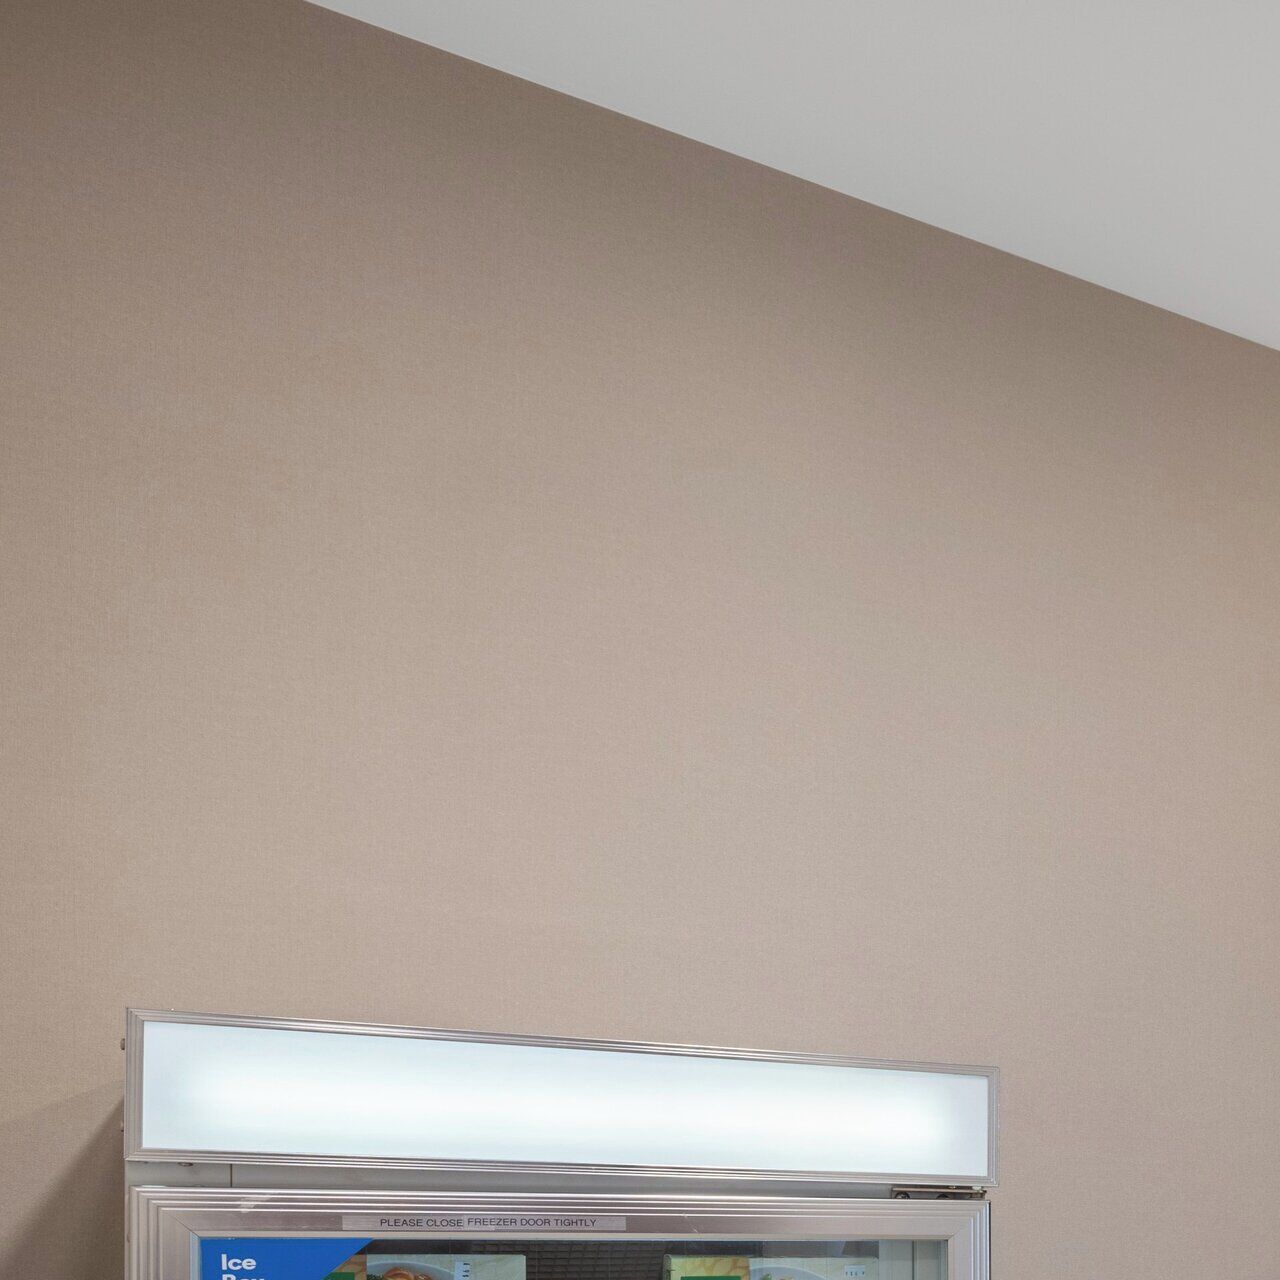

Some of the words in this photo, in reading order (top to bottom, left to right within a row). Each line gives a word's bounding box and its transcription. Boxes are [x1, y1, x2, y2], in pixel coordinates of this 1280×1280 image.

[380, 1218, 423, 1227] PLEASE
[427, 1218, 463, 1227] CLOSE
[468, 1218, 517, 1226] FREEZER
[520, 1218, 550, 1226] DOOR
[554, 1218, 596, 1227] TIGHTLY
[221, 1254, 256, 1270] Ice
